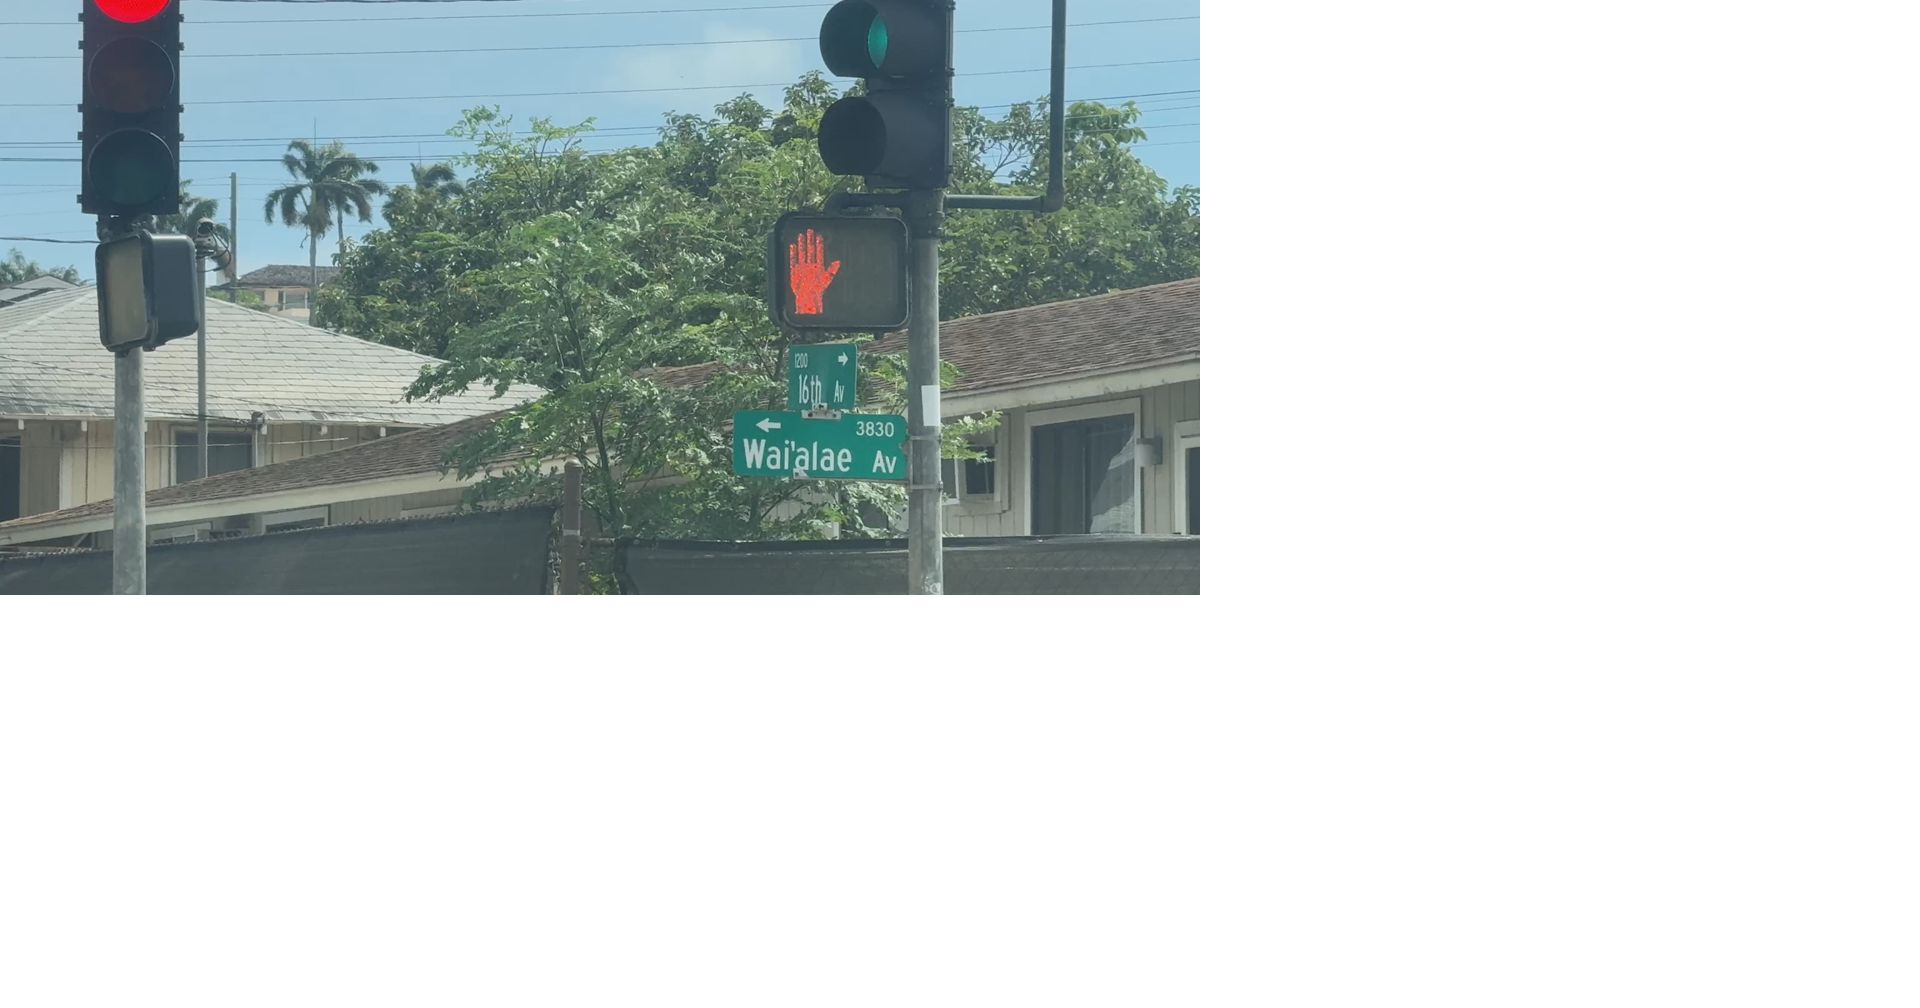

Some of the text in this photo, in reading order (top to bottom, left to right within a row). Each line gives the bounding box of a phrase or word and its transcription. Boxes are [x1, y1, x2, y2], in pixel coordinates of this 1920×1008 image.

[794, 353, 808, 368] 1200
[798, 374, 845, 405] 16th Av
[855, 421, 895, 437] 3830
[743, 438, 897, 474] Wai'alae Av
